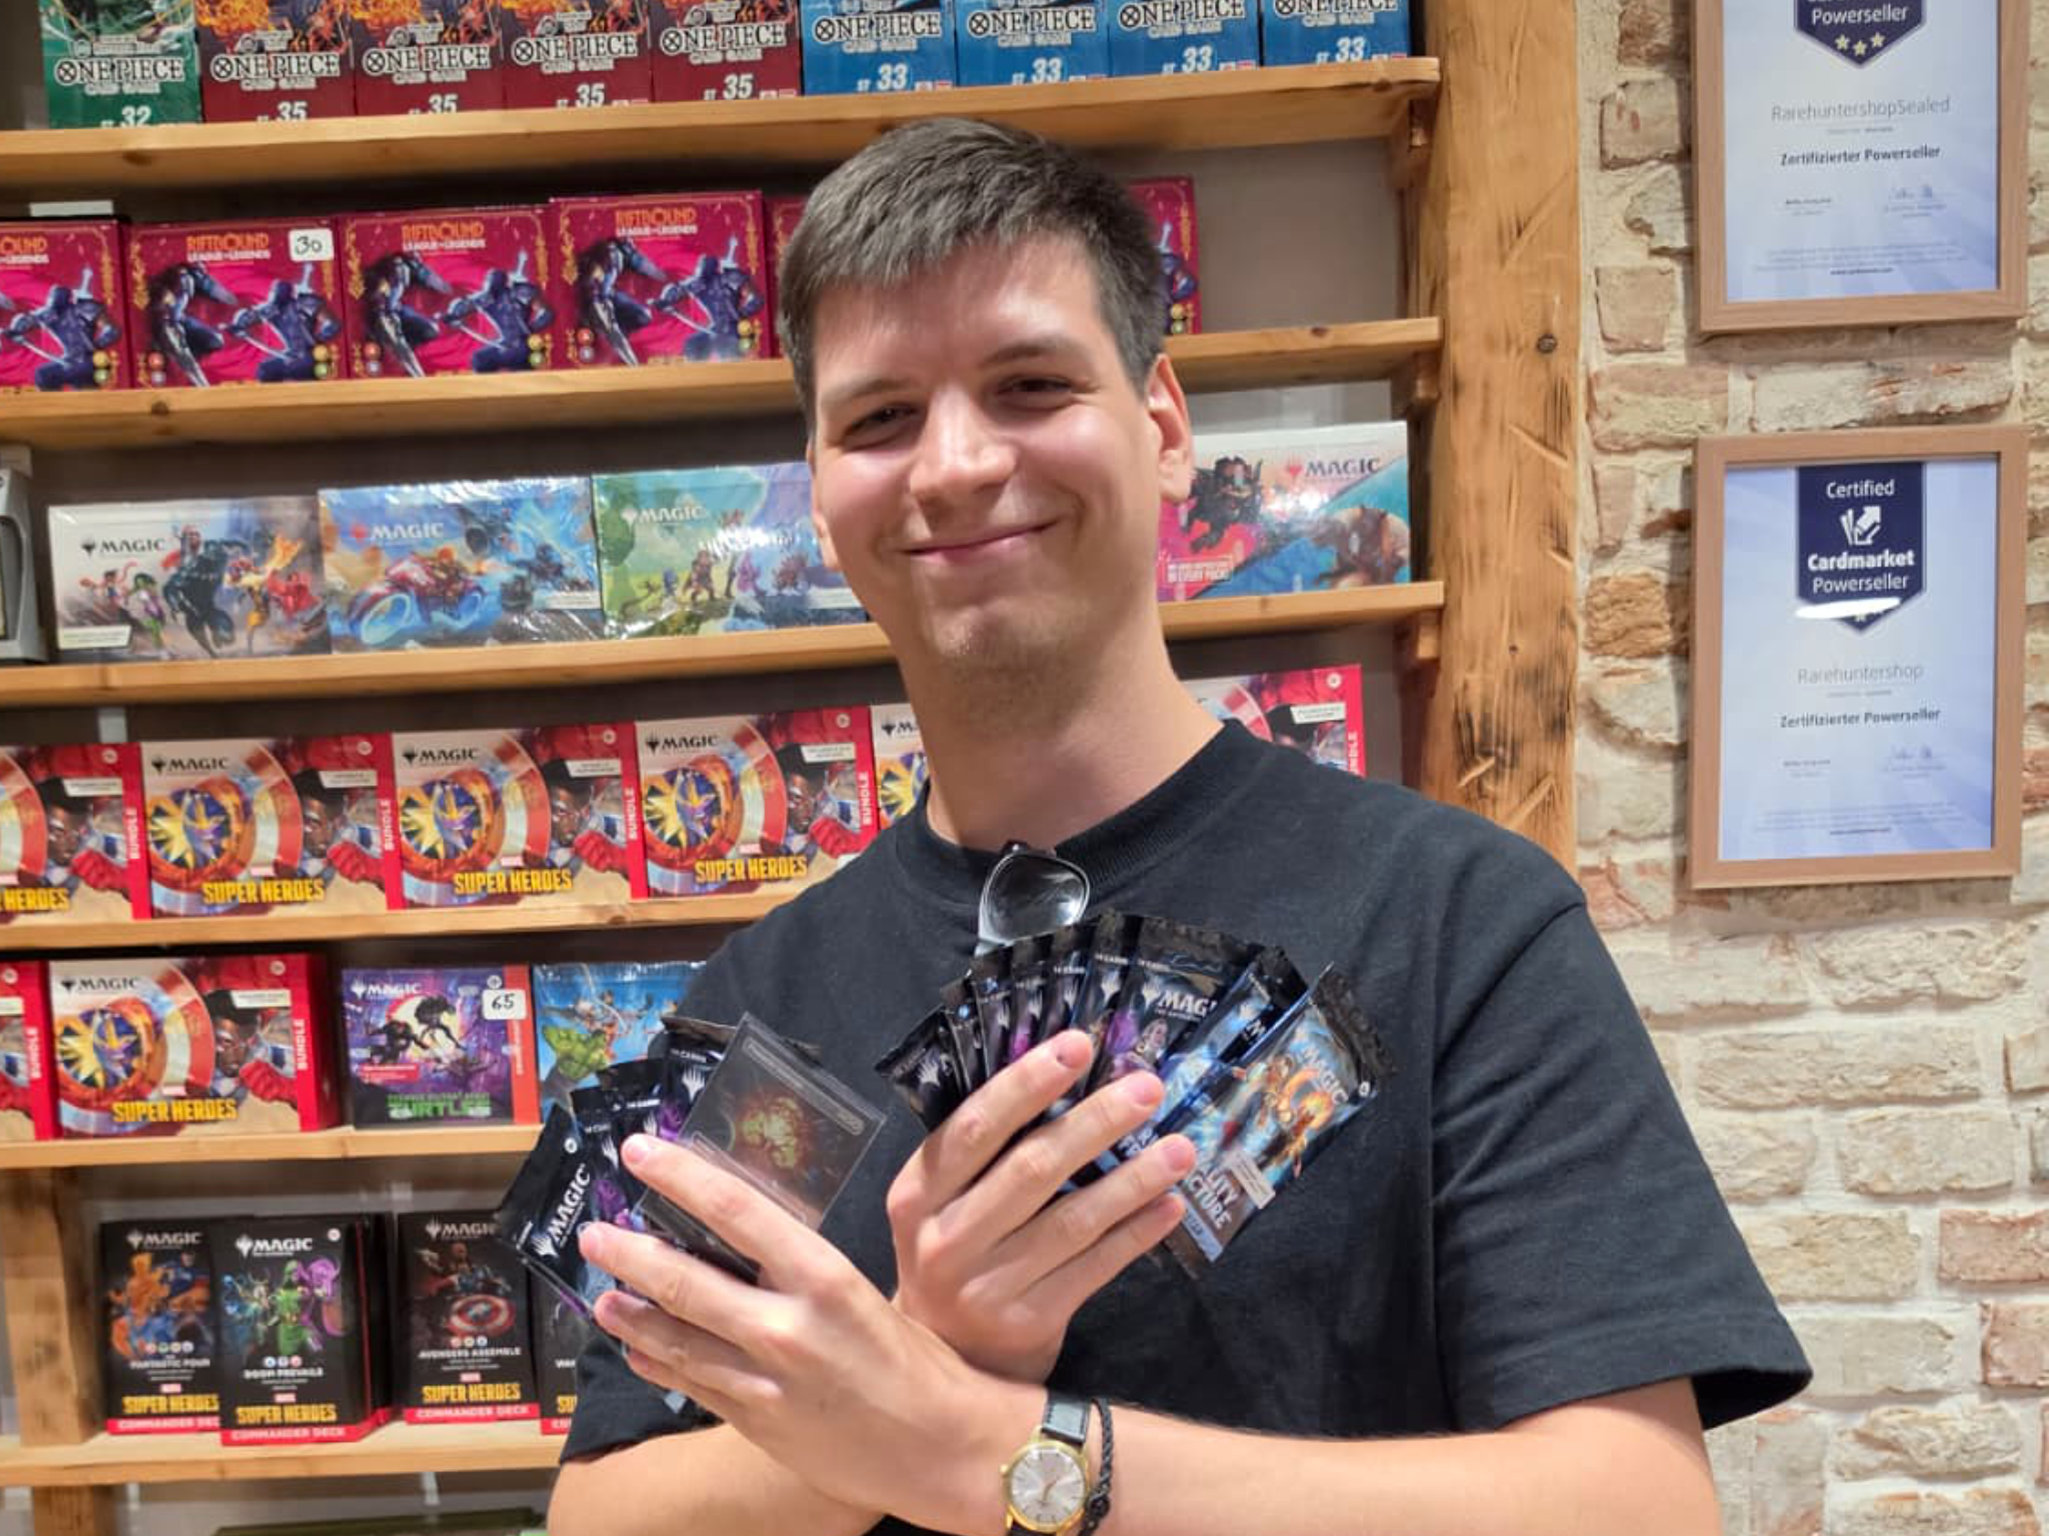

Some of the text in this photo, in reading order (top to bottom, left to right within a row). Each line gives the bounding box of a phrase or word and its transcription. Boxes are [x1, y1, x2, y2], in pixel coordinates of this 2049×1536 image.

[970, 6, 1094, 37] ONE PIECE
[1120, 0, 1244, 29] ONE PIECE
[1812, 5, 1908, 25] Powerseller
[662, 22, 786, 52] ONE PIECE
[814, 13, 941, 42] ONE PIECE
[364, 45, 490, 74] ONE PIECE
[514, 33, 637, 63] ONE PIECE
[1182, 45, 1213, 72] 33
[1335, 37, 1366, 62] 33
[56, 57, 184, 84] ONE PIECE
[212, 52, 339, 80] ONE PIECE
[876, 63, 907, 90] 33
[1032, 58, 1063, 83] 33
[575, 83, 606, 107] 35
[722, 73, 753, 99] 35
[276, 101, 308, 121] 35
[428, 94, 459, 115] 35
[1771, 96, 1951, 122] RarehuntershopSealed
[121, 106, 150, 127] 32
[1780, 144, 1941, 166] Zertifizierter Powerseller
[295, 236, 322, 255] 30
[1305, 458, 1380, 477] MAGIC
[1826, 479, 1895, 500] Certified
[637, 506, 706, 526] MAGIC
[369, 523, 444, 540] MAGIC
[100, 538, 166, 553] MAGIC
[1808, 550, 1915, 571] Cardmarket
[1813, 574, 1909, 594] Powerseller
[1798, 663, 1925, 686] Rarehuntershop
[1780, 708, 1941, 730] Zertifizierter Powerseller
[661, 735, 718, 750] MAGIC
[169, 757, 230, 771] MAGIC
[419, 748, 479, 762] MAGIC
[858, 771, 871, 826] BUNDLE
[383, 799, 395, 851] BUNDLE
[625, 787, 637, 840] BUNDLE
[127, 807, 139, 860] BUNDLE
[694, 855, 808, 883] SUPER HEROES
[202, 878, 325, 904] SUPER HEROES
[454, 868, 574, 895] SUPER HEROES
[5, 888, 70, 911] HEROES
[78, 977, 140, 991] MAGIC
[367, 982, 422, 995] MAGIC
[491, 993, 515, 1010] 65
[27, 1027, 41, 1080] BUNDLE
[293, 1018, 307, 1071] BUNDLE
[112, 1098, 238, 1123] SUPER HEROES
[548, 1163, 590, 1242] MAGIC
[1188, 1177, 1232, 1230] CTURE
[143, 1231, 201, 1245] MAGIC
[252, 1238, 313, 1251] MAGIC
[121, 1394, 219, 1414] SUPER HEROES
[422, 1383, 521, 1403] SUPER HEROES
[236, 1404, 337, 1424] SUPER HEROES
